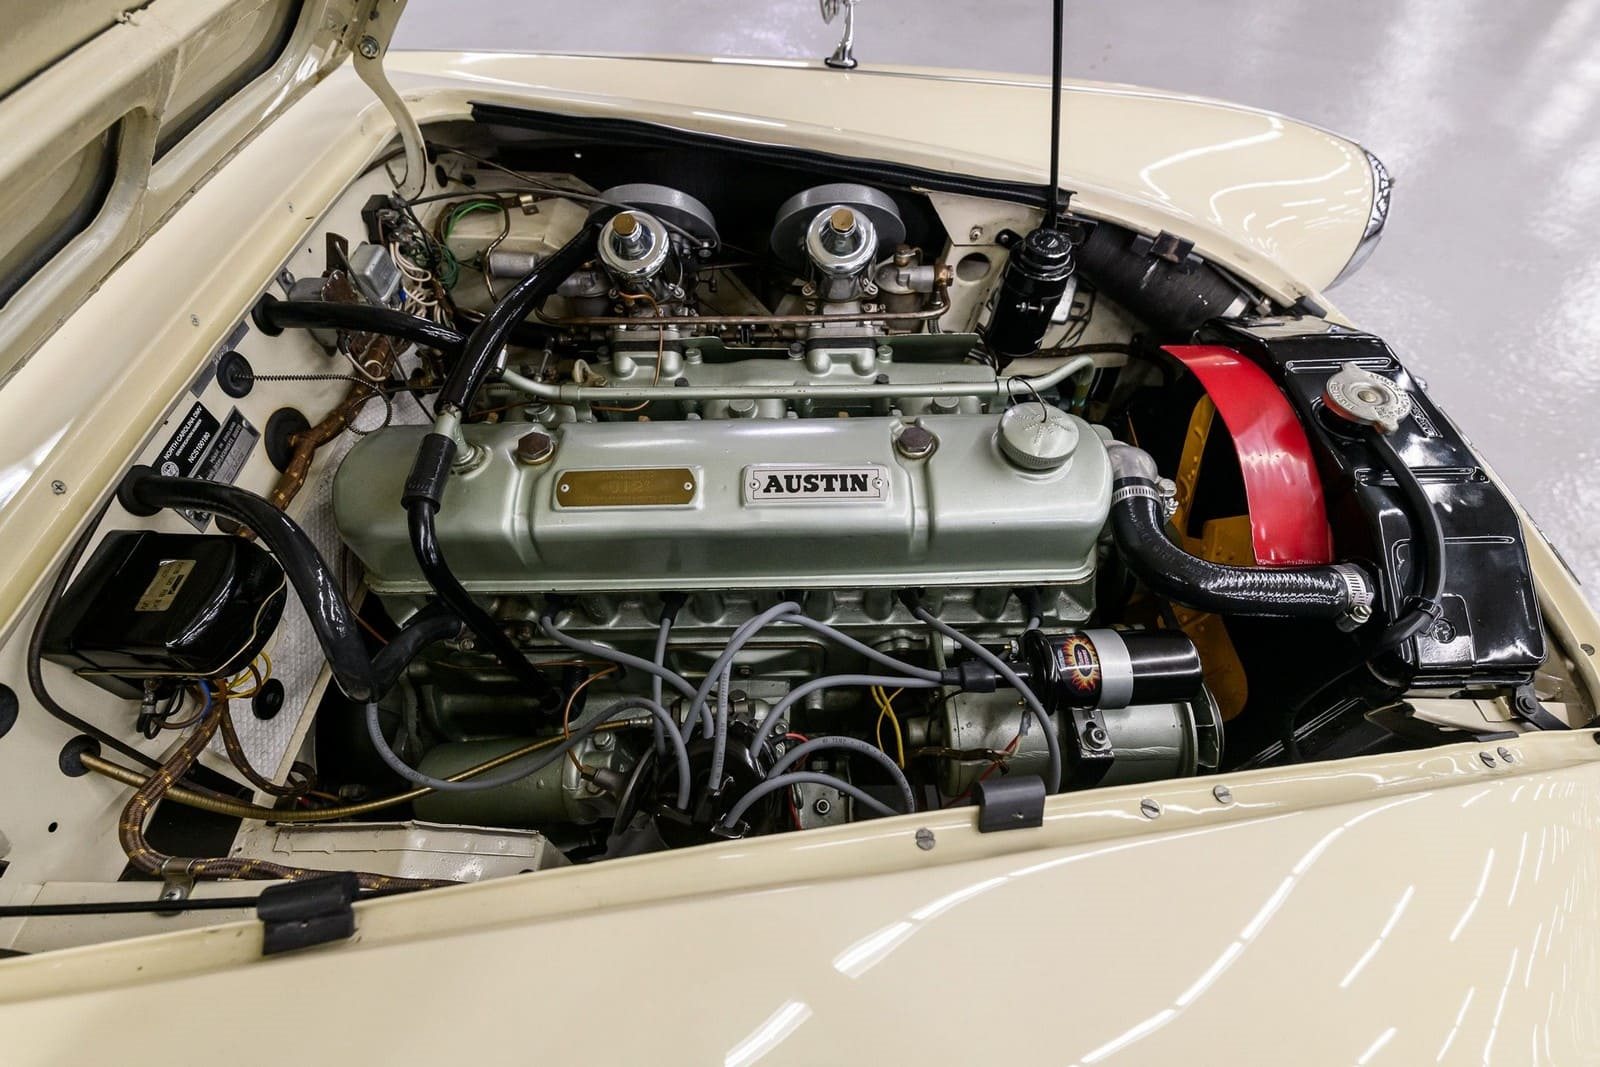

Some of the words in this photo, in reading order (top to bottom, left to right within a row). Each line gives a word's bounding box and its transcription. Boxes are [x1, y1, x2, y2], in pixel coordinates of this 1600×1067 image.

[163, 441, 179, 460] NORTH
[176, 417, 194, 442] CAROLINA
[763, 474, 868, 493] AUSTIN
